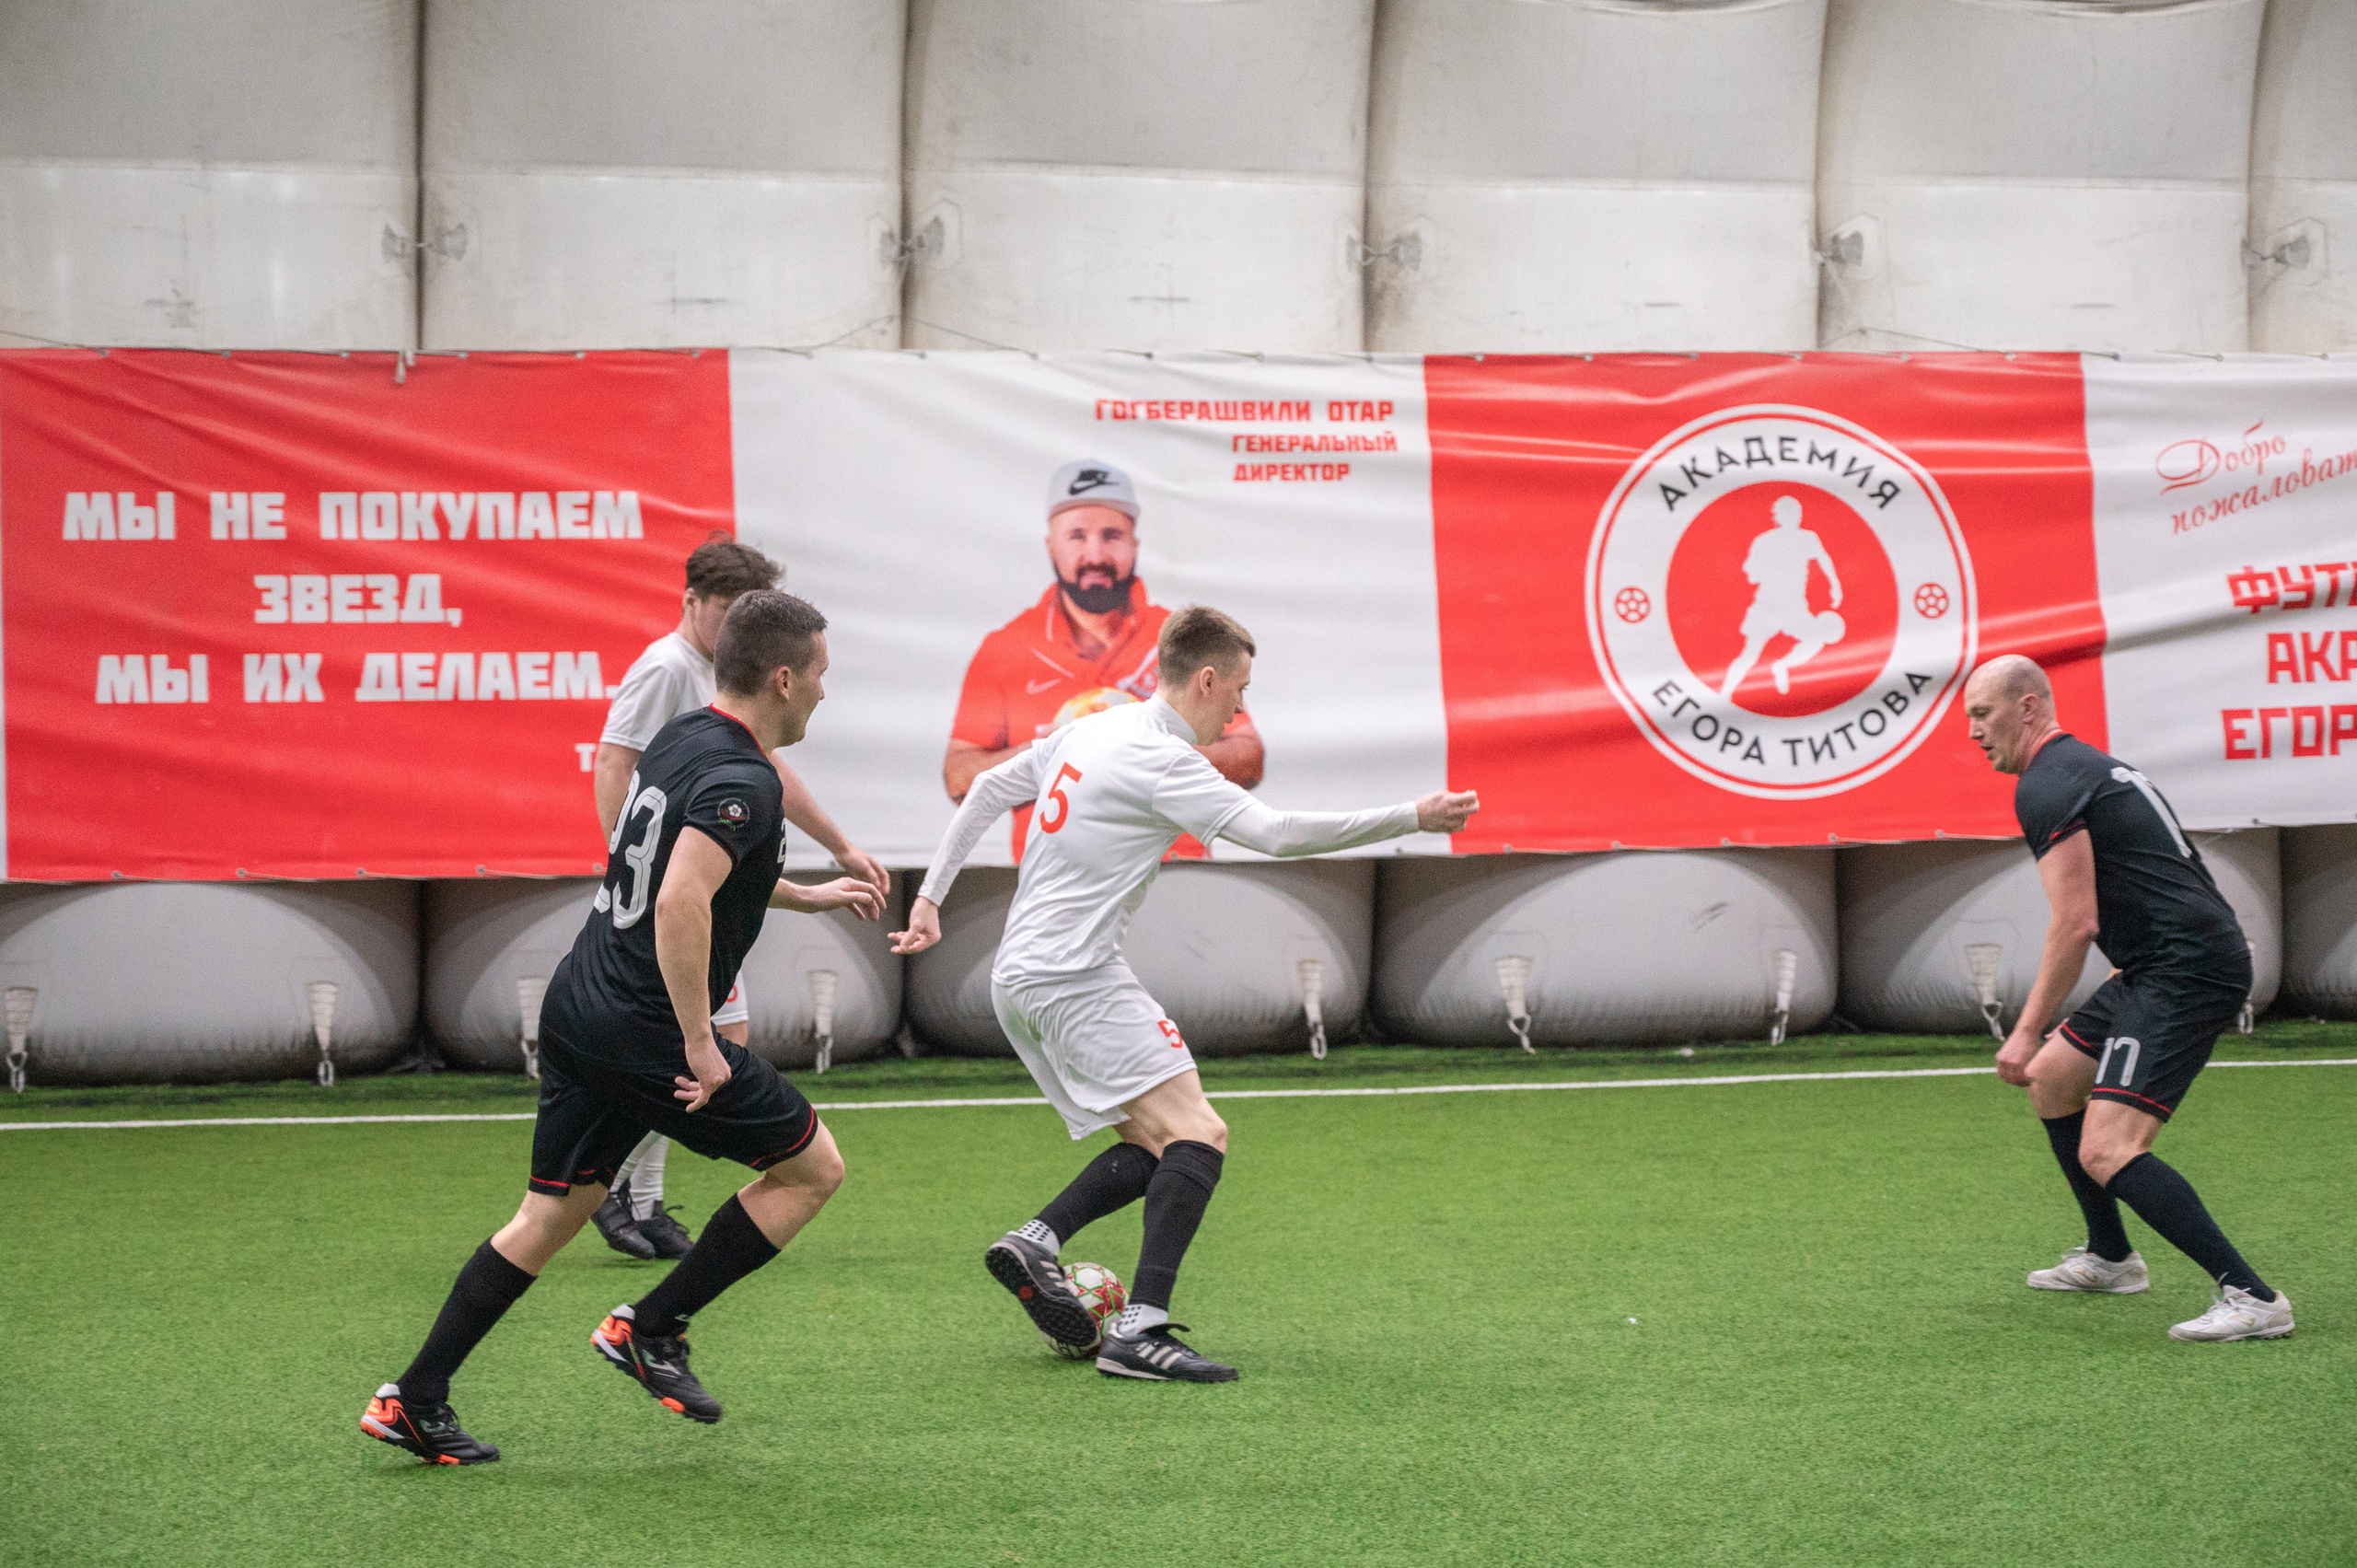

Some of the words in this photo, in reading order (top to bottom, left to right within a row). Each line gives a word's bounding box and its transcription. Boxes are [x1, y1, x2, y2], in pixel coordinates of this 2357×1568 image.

[1096, 399, 1311, 421] ГОГБЕРАШВИЛИ
[1328, 400, 1394, 422] ОТАР
[1233, 430, 1398, 452] ГЕНЕРАЛЬНЫЙ
[2155, 419, 2287, 495] Добро
[1233, 463, 1350, 482] ДИРЕКТОР
[1658, 436, 1901, 511] АКАДЕМИЯ
[63, 492, 176, 540] МЫ
[211, 492, 286, 540] НЕ
[319, 492, 644, 540] ПОКУПАЕМ
[254, 575, 461, 627] ЗВЕЗД,
[96, 654, 209, 703] МЫ
[243, 654, 324, 703] ИХ
[1652, 680, 1765, 766] ЕГОРА
[1782, 670, 1932, 767] ТИТОВА
[1039, 761, 1083, 834] 5
[1157, 1020, 1184, 1049] 5
[2095, 1037, 2141, 1086] 17
